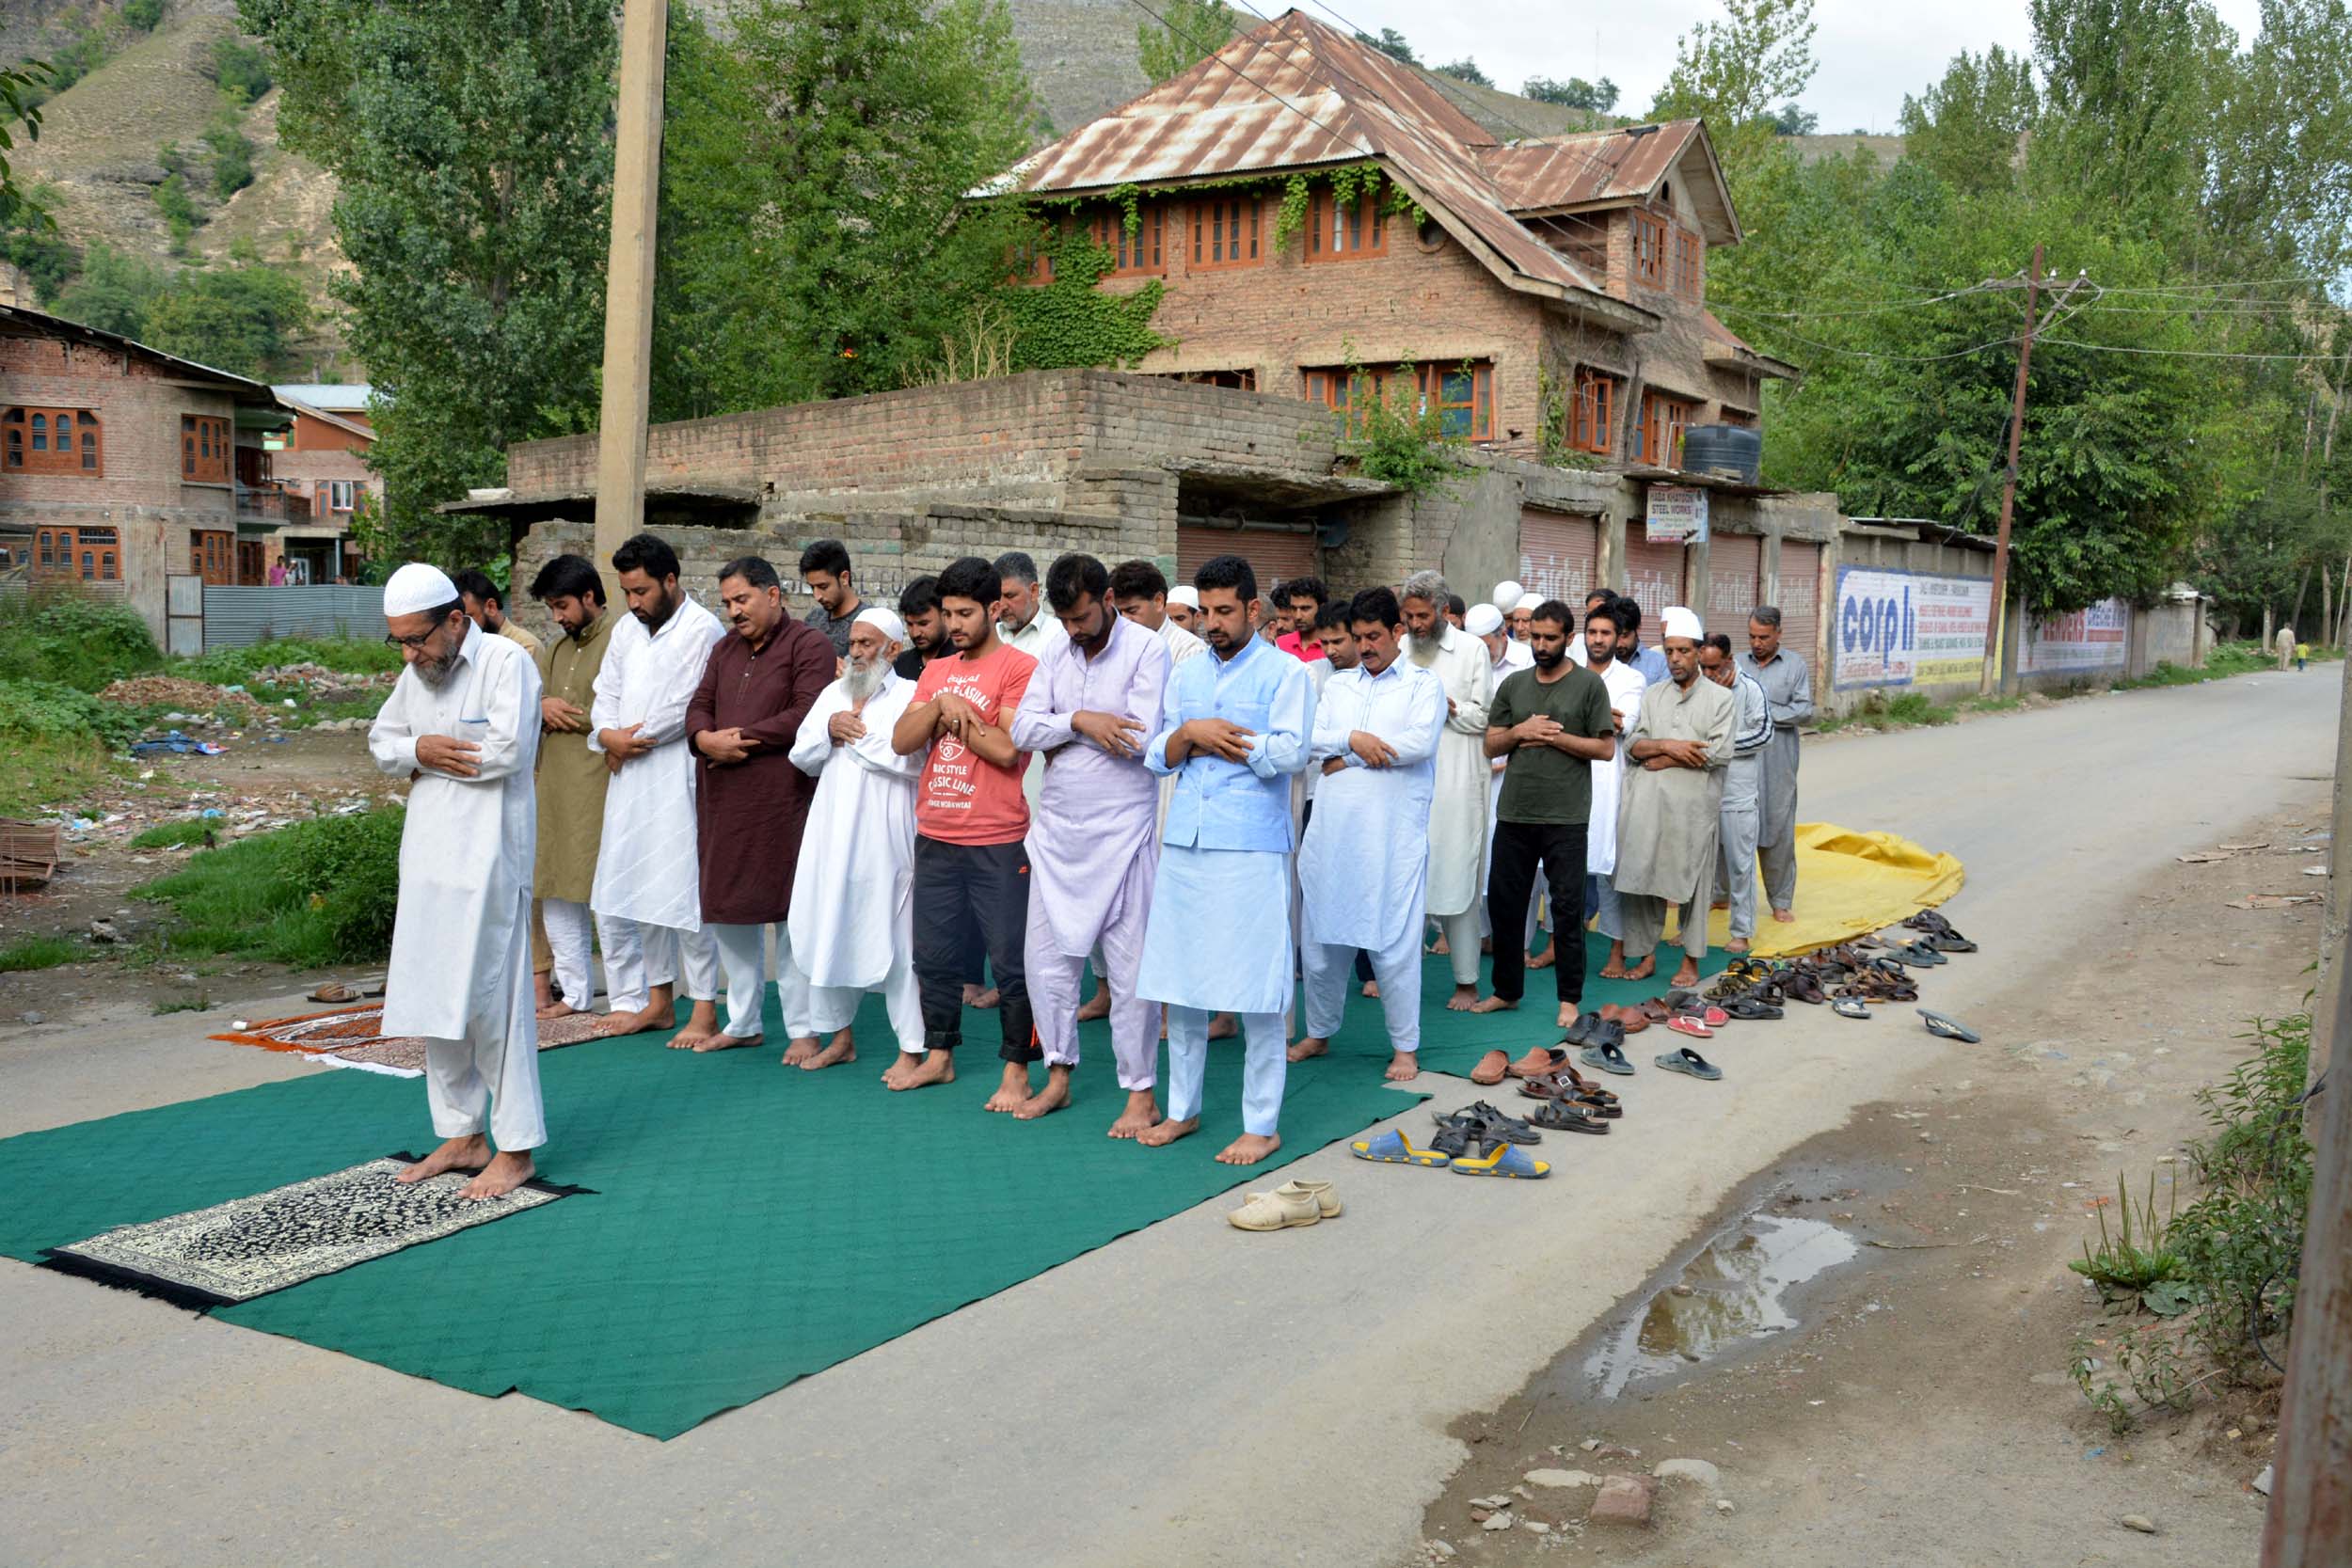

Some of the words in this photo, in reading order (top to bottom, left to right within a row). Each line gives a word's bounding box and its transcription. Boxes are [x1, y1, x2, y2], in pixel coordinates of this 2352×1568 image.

[1652, 504, 1670, 515] STEEL
[946, 764, 967, 775] STYLE
[952, 778, 977, 796] LINE
